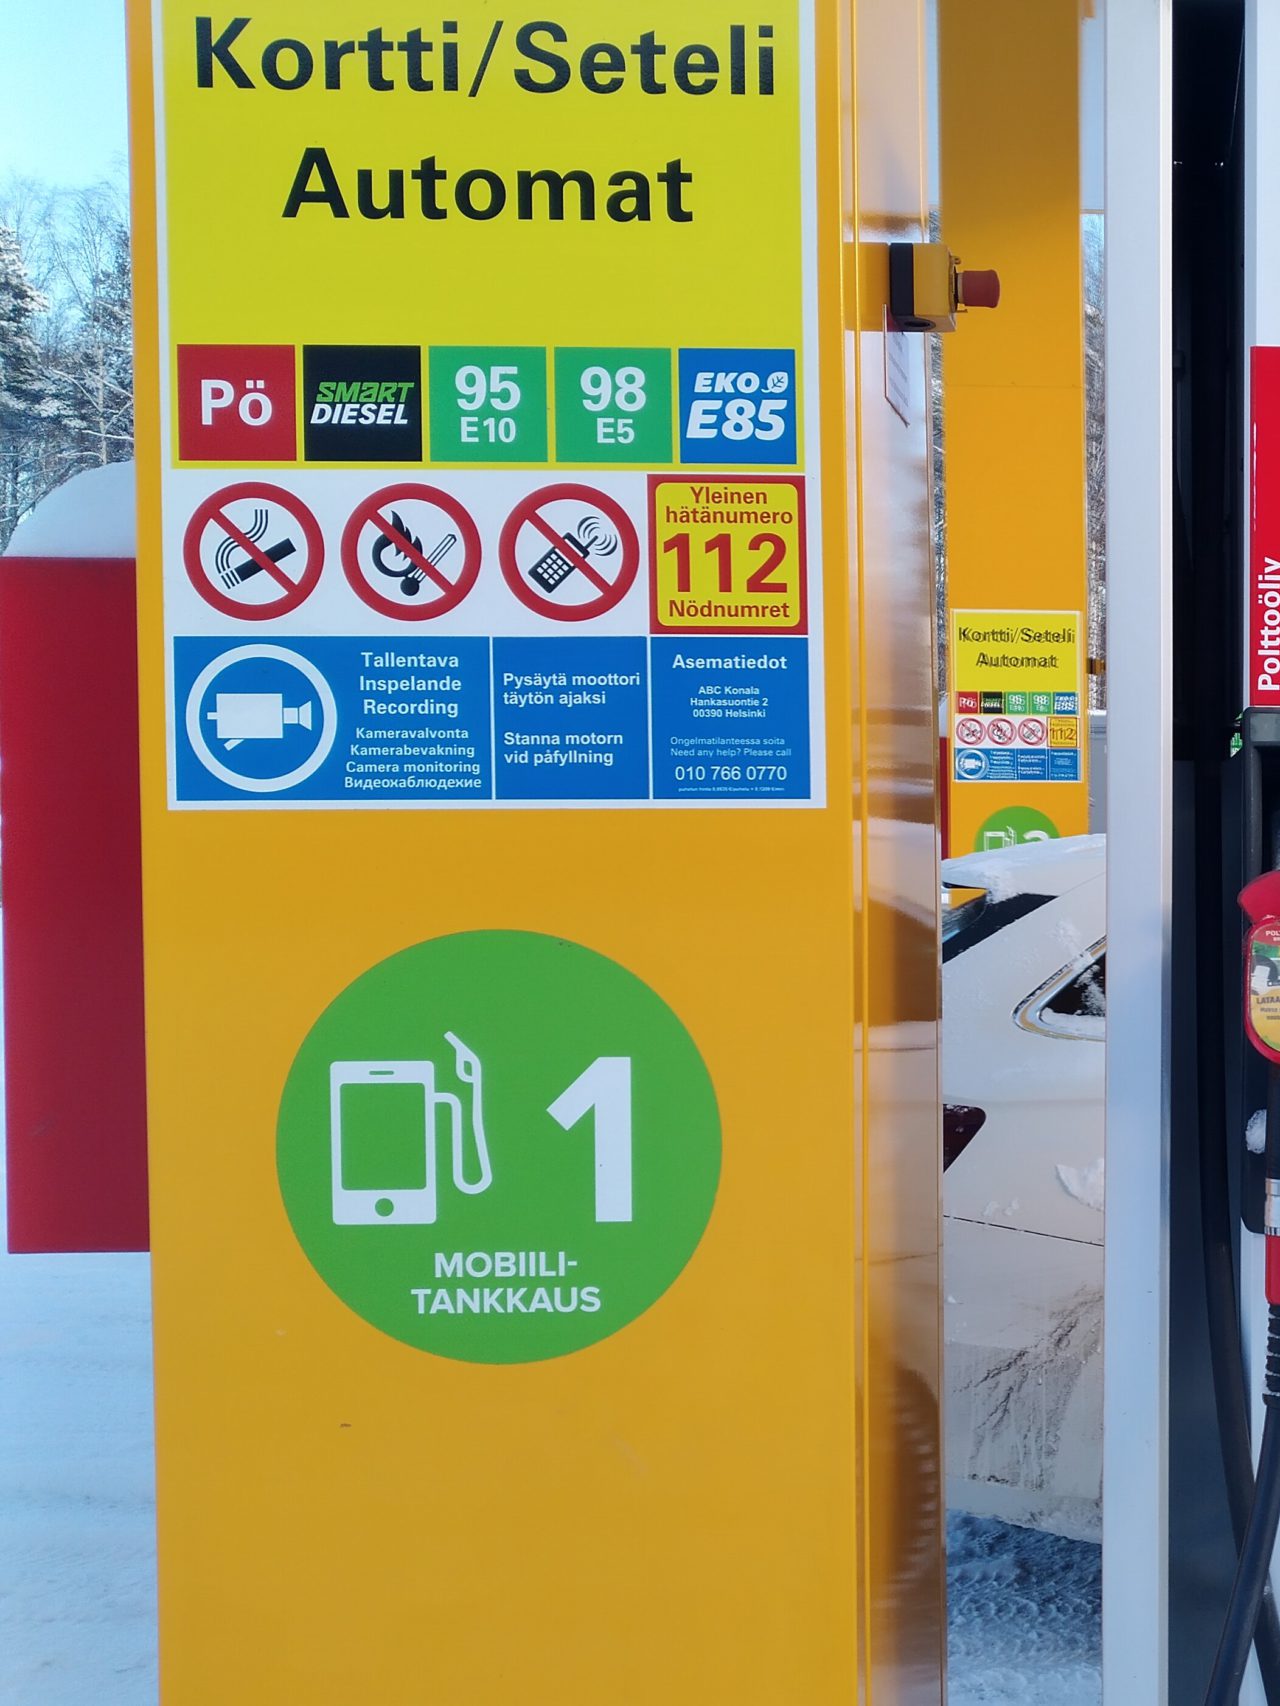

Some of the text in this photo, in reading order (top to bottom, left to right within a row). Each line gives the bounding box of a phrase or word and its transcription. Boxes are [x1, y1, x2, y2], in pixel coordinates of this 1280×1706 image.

[195, 16, 775, 97] Kortti/Seteli
[281, 146, 694, 223] Automat
[454, 365, 521, 412] 95
[580, 366, 647, 412] 98
[694, 371, 760, 394] EKO
[315, 381, 415, 403] SMART
[199, 379, 273, 426] Pö
[310, 403, 408, 425] DIESEL
[686, 398, 788, 441] E85
[460, 416, 516, 443] E10
[596, 417, 635, 444] E5
[690, 486, 767, 504] Yleinen
[666, 506, 793, 524] hätänumero
[663, 533, 787, 593] 112
[669, 600, 789, 618] Nödnumret
[959, 627, 1075, 643] Kortti/Seteli
[361, 652, 459, 668] Tallentava
[672, 654, 787, 669] Asematiedot
[976, 652, 1058, 668] Automat
[360, 676, 461, 694] Inspelande
[503, 673, 640, 689] Pysäytä moottori
[698, 686, 721, 694] ABC
[363, 699, 458, 717] Recording
[503, 691, 606, 707] täytön ajaksi
[690, 698, 768, 706] Hankasuontie 2
[693, 709, 766, 717] 00390 Helsinki
[356, 728, 469, 739] Kameravalvonta
[504, 732, 623, 745] Stanna motorn
[671, 736, 785, 746] Ongelmatilanteessa soita
[350, 745, 475, 758] Kamerabevakning
[504, 749, 613, 766] vid påfyllning
[697, 750, 713, 758] any
[717, 749, 741, 758] help?
[346, 761, 480, 775] Camera monitoring
[675, 766, 787, 781] 010 766 0770
[546, 1057, 632, 1223] 1
[434, 1251, 577, 1278] MOBIILI-
[411, 1287, 601, 1314] TANKKAUS
